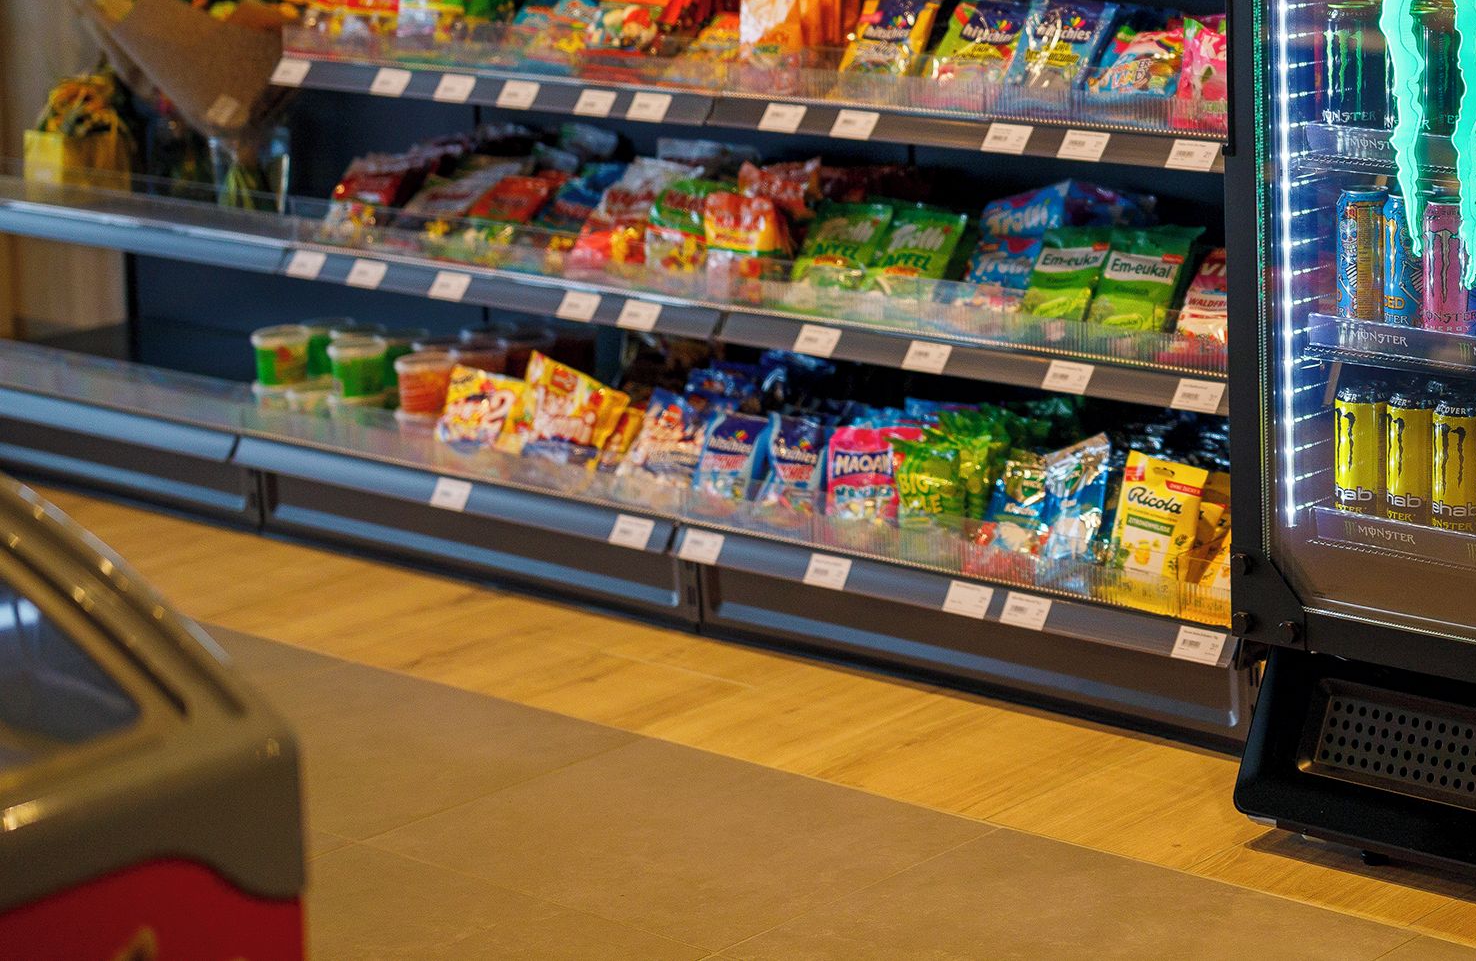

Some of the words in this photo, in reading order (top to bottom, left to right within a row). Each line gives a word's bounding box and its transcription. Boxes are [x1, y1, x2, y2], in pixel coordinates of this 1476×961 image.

[1110, 258, 1173, 279] Em-eukal
[1350, 328, 1409, 347] MONSTER
[1127, 486, 1182, 516] Ricola
[1357, 525, 1416, 545] MONSTER
